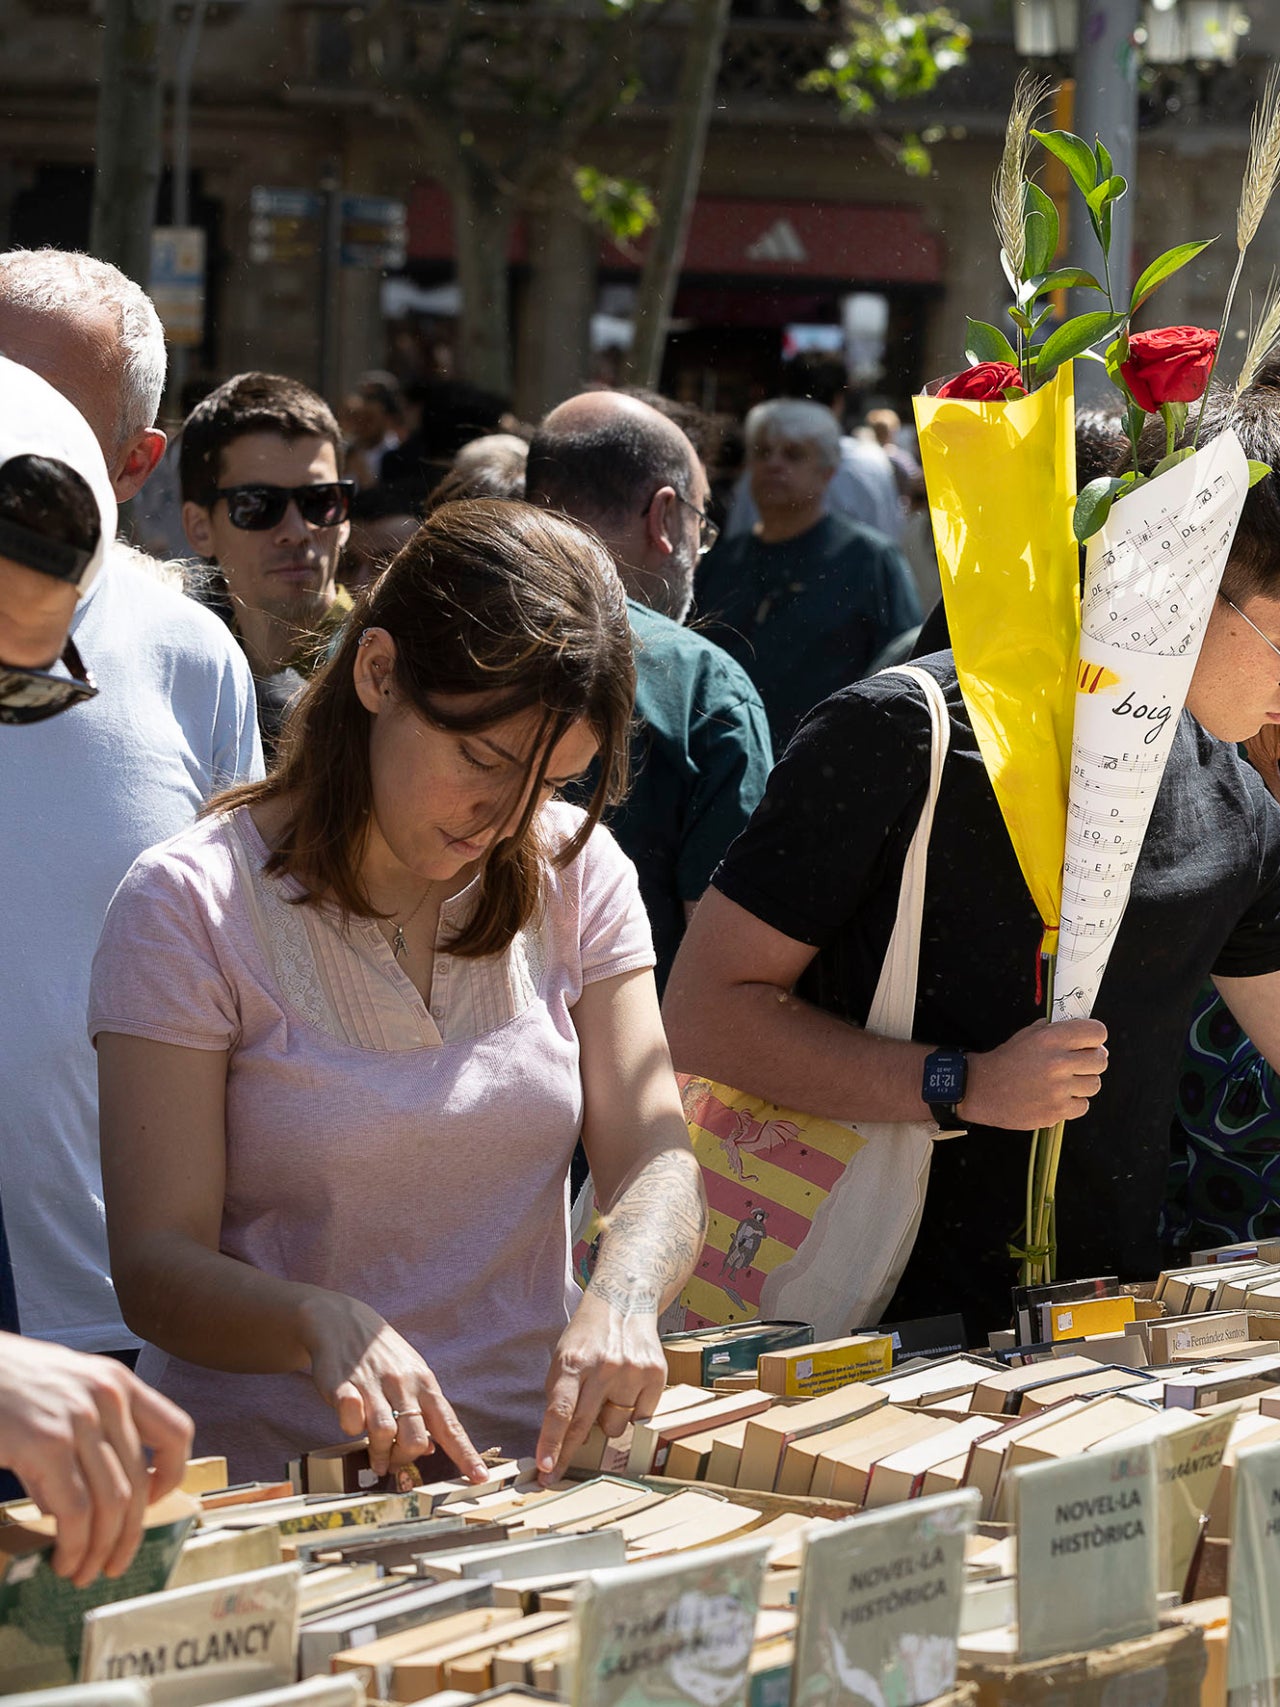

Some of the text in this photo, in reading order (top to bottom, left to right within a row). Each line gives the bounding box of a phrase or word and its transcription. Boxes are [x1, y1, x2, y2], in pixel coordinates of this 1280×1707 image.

[1111, 691, 1172, 744] boig
[929, 1074, 955, 1087] 12:13
[1190, 1331, 1225, 1346] Fernández
[1225, 1327, 1247, 1340] Santos
[1055, 1488, 1142, 1525] NOVEL·LA
[1050, 1519, 1146, 1557] HISTÒRICA
[106, 1620, 276, 1681] TOM CLANCY
